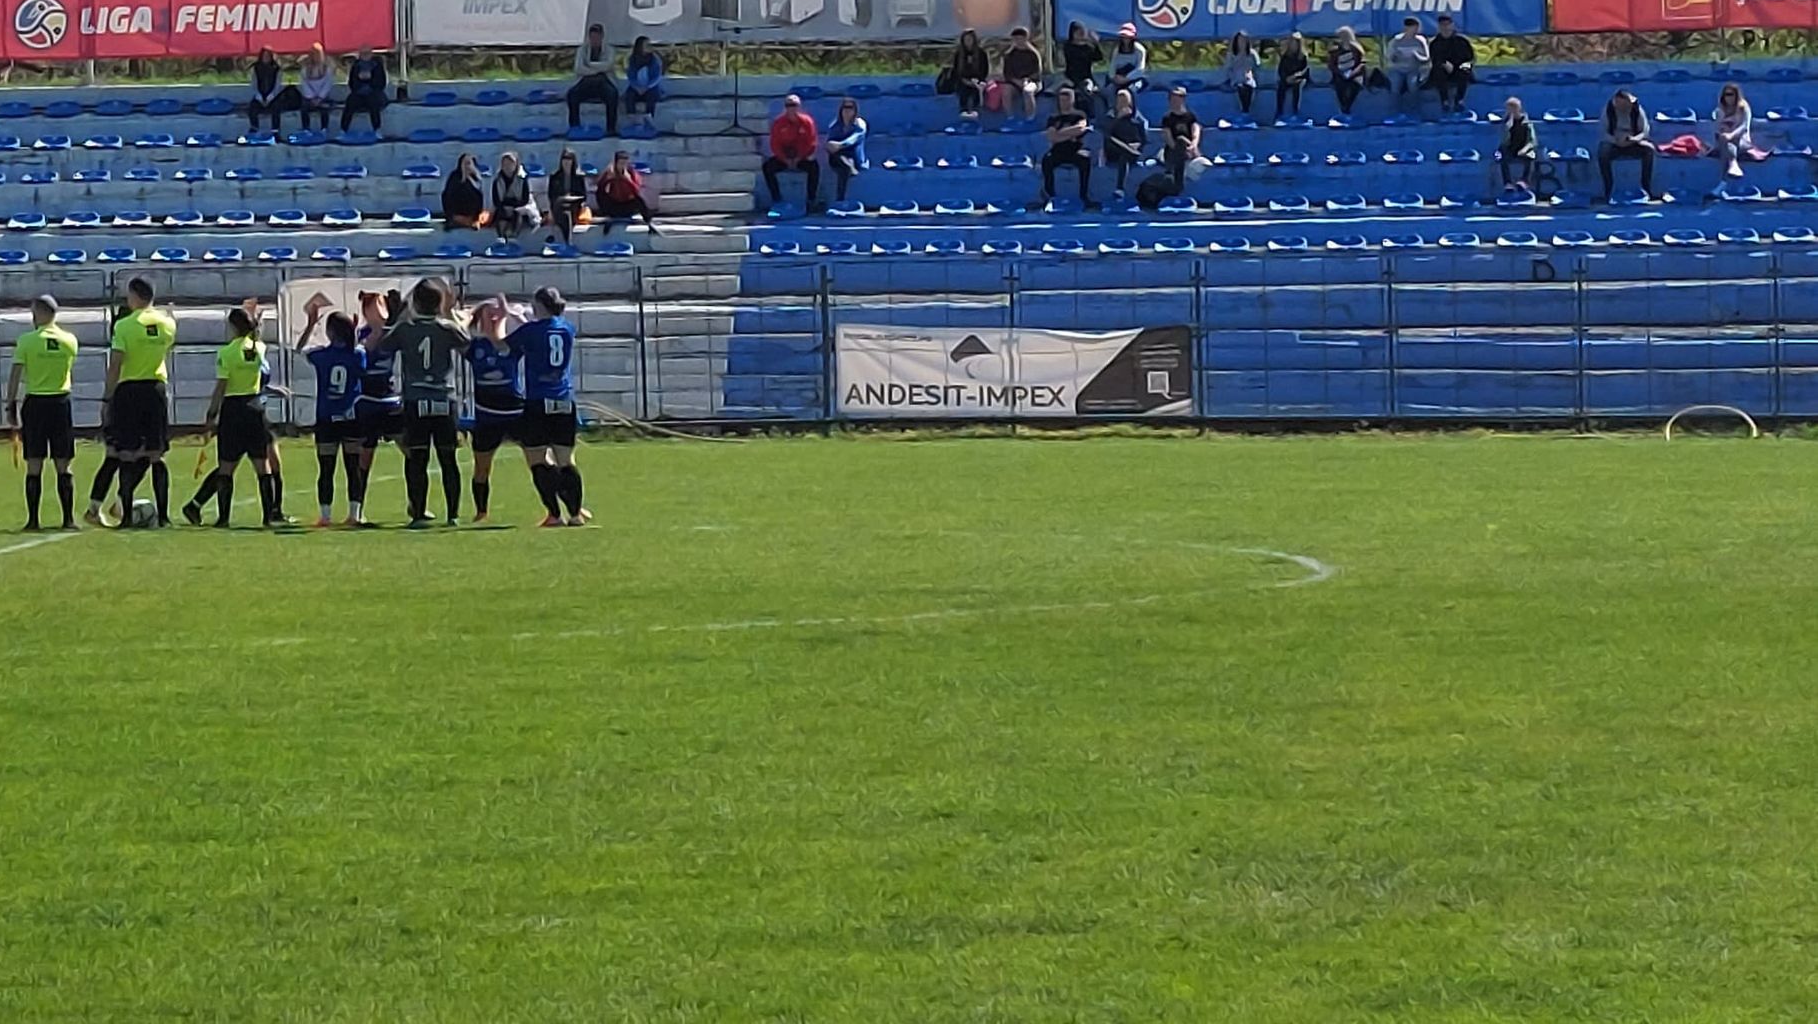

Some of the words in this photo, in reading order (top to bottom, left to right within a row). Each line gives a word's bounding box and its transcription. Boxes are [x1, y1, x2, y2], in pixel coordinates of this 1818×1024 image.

[80, 6, 153, 34] LIGA
[175, 1, 319, 33] FEMININ
[418, 336, 431, 369] 1
[549, 334, 564, 367] 8
[329, 366, 347, 394] 9
[844, 382, 1067, 408] ANDESIT-IMPEX
